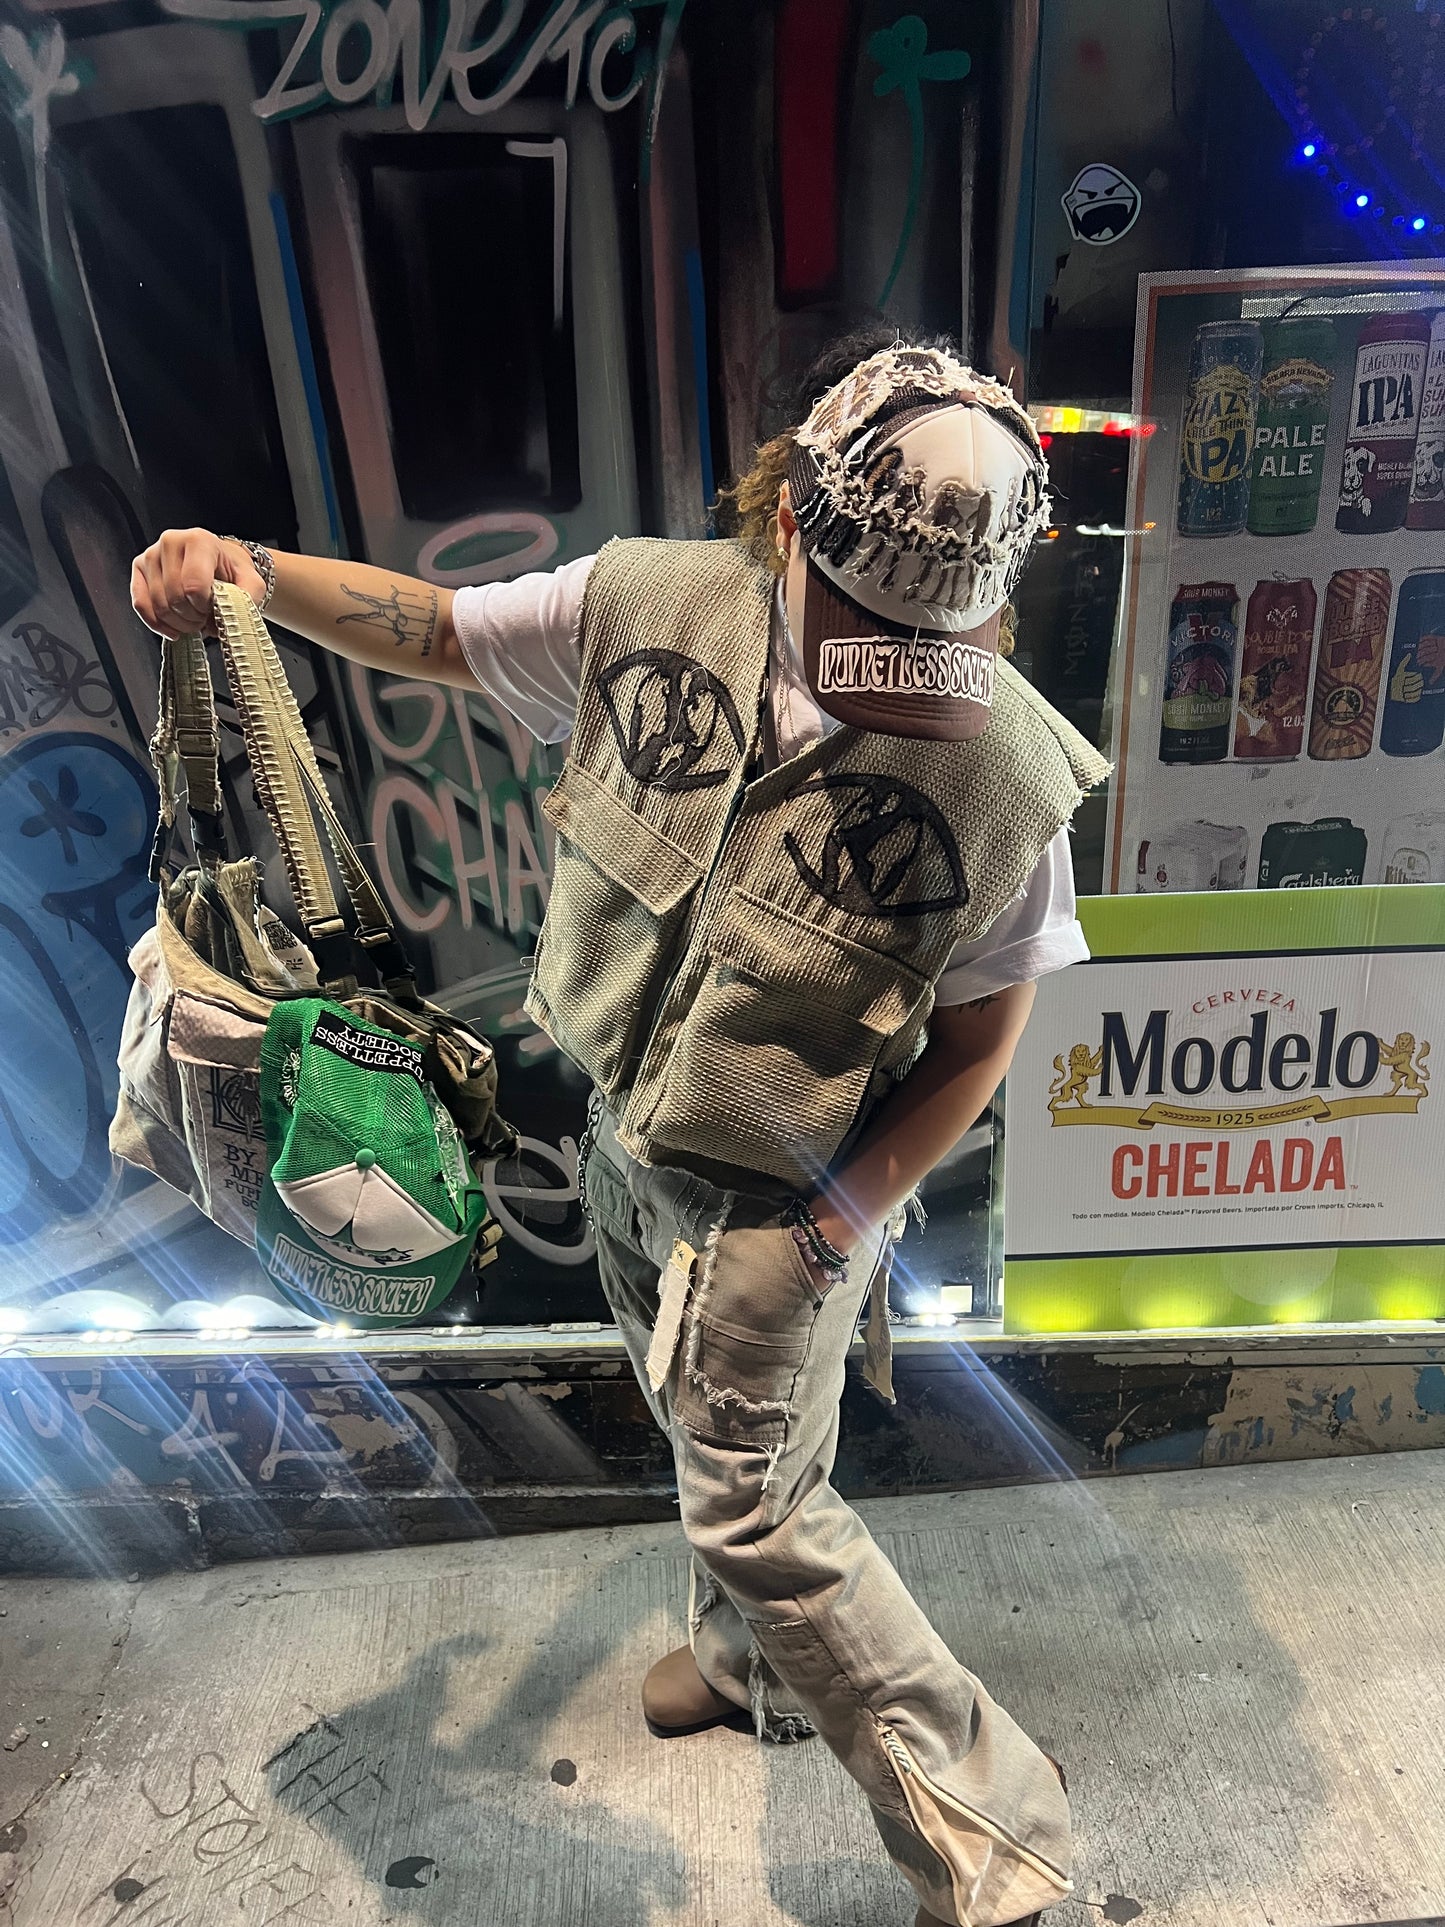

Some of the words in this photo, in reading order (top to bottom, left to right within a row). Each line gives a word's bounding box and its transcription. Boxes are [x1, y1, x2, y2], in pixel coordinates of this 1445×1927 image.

[1362, 353, 1421, 374] LAGUNITAS
[1188, 391, 1251, 423] HAZY
[1357, 374, 1414, 427] IPA
[1255, 424, 1327, 448] PALE
[1187, 430, 1247, 477] IPA
[1259, 453, 1313, 477] ALE
[1201, 587, 1229, 597] MONKEY
[821, 640, 950, 693] PUPPETLESS
[1190, 701, 1228, 715] MONKEY
[1279, 868, 1360, 888] Carlsberg
[1191, 988, 1298, 1015] CERVEZA
[338, 1025, 422, 1063] SOCIETY
[1098, 1007, 1381, 1098] Modelo
[1216, 1112, 1255, 1126] 1925
[223, 1142, 258, 1168] BY
[1111, 1136, 1346, 1200] CHELADA
[1191, 1207, 1221, 1215] Flavored
[1245, 1205, 1280, 1213] Importada
[1281, 1204, 1293, 1212] por
[359, 1278, 432, 1315] SOCIETY
